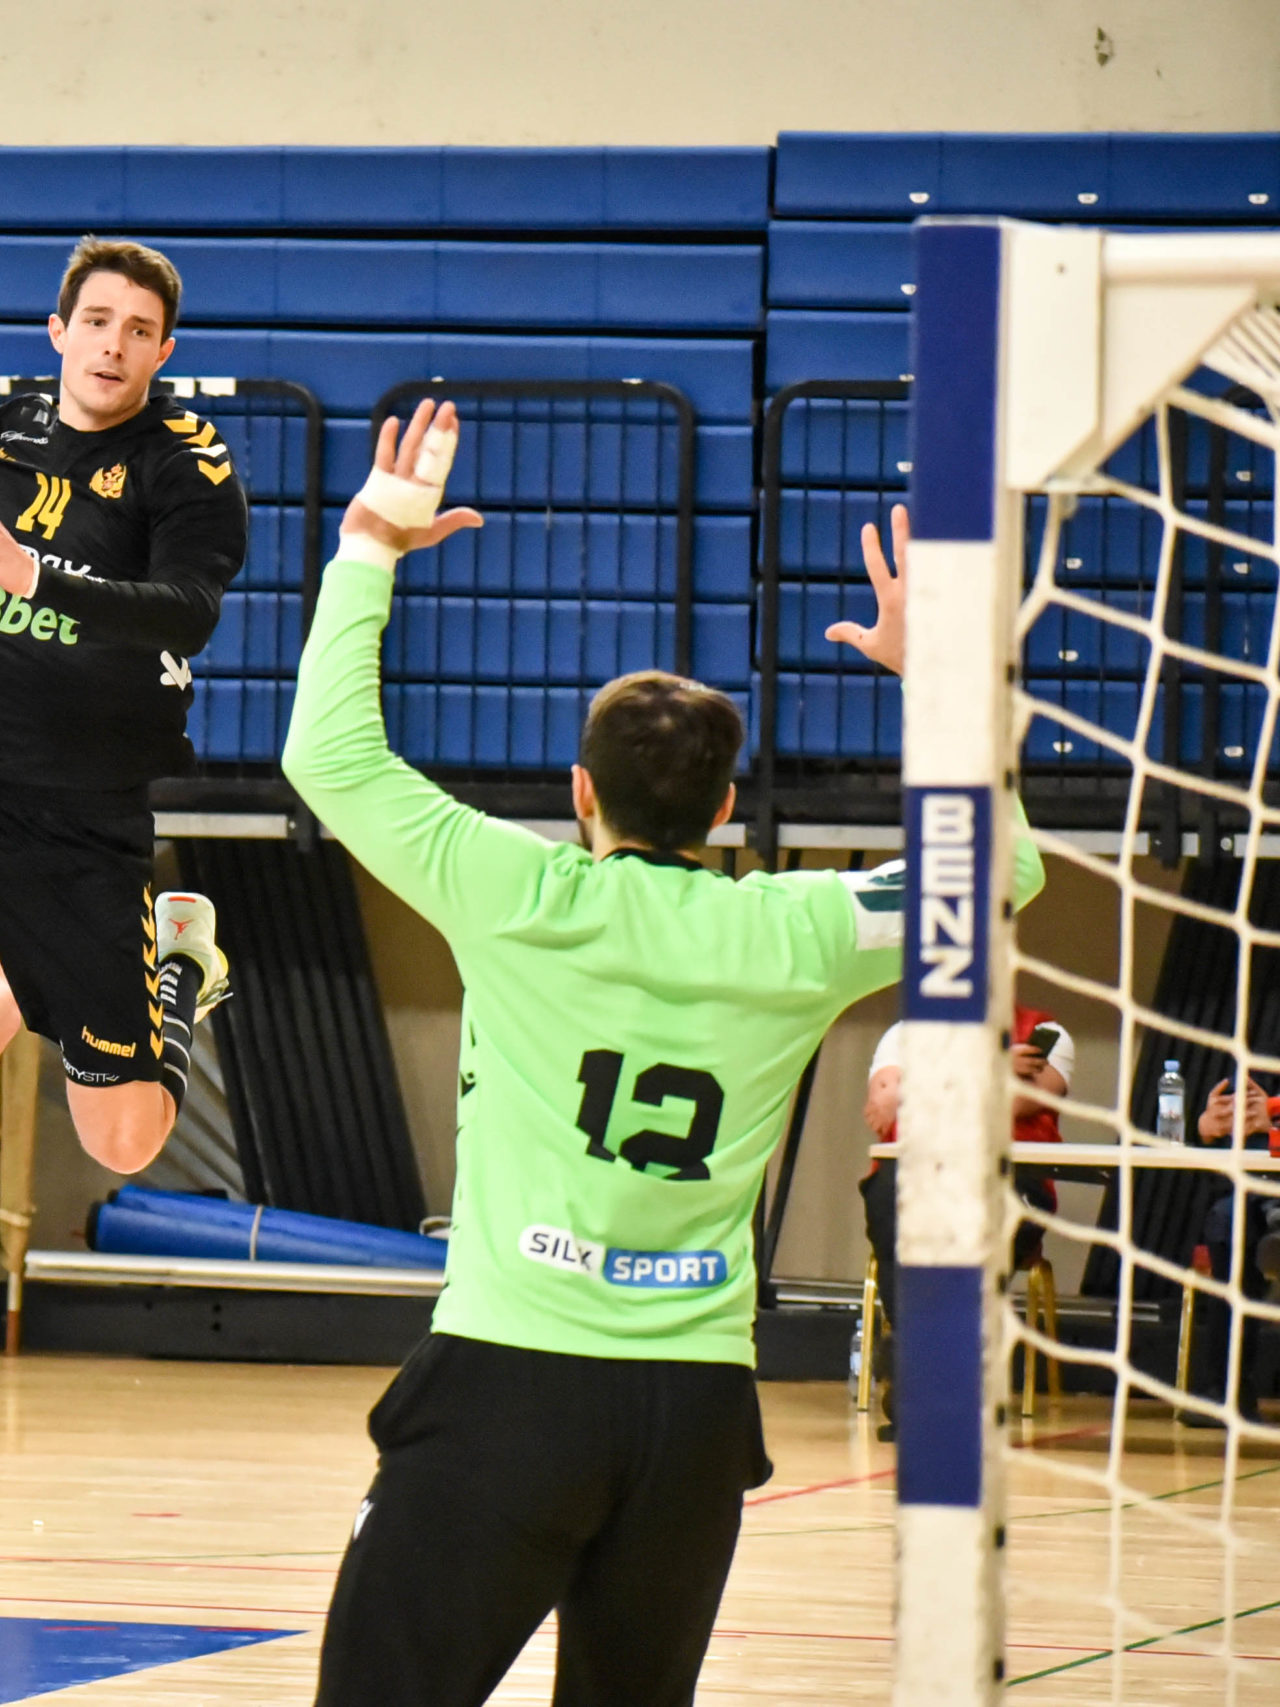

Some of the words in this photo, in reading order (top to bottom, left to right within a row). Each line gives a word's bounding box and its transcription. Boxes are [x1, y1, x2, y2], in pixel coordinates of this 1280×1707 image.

[920, 793, 975, 998] BENZ
[81, 1025, 136, 1058] hummel
[575, 1048, 725, 1181] 12
[529, 1232, 593, 1272] SILK
[612, 1256, 719, 1282] SPORT
